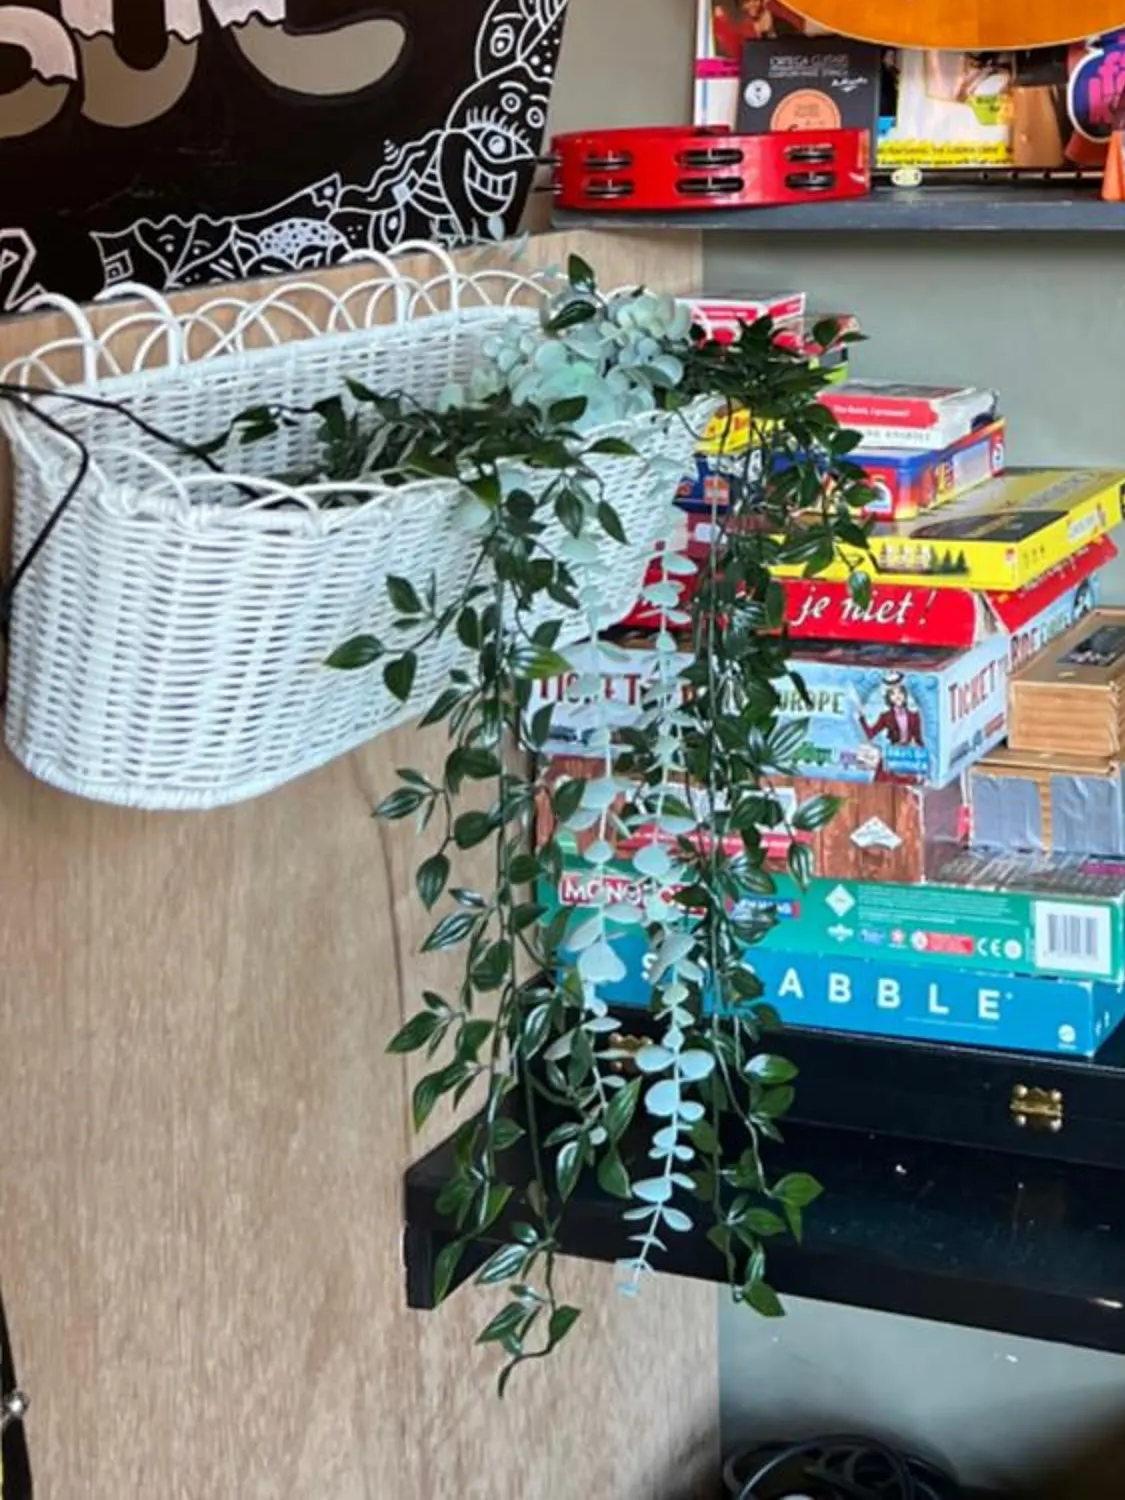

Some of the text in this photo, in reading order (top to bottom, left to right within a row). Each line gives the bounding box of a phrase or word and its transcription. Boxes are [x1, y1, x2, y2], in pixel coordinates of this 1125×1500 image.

[791, 586, 829, 626] je
[776, 689, 846, 716] UROPE
[641, 952, 1002, 1021] SABBLE
